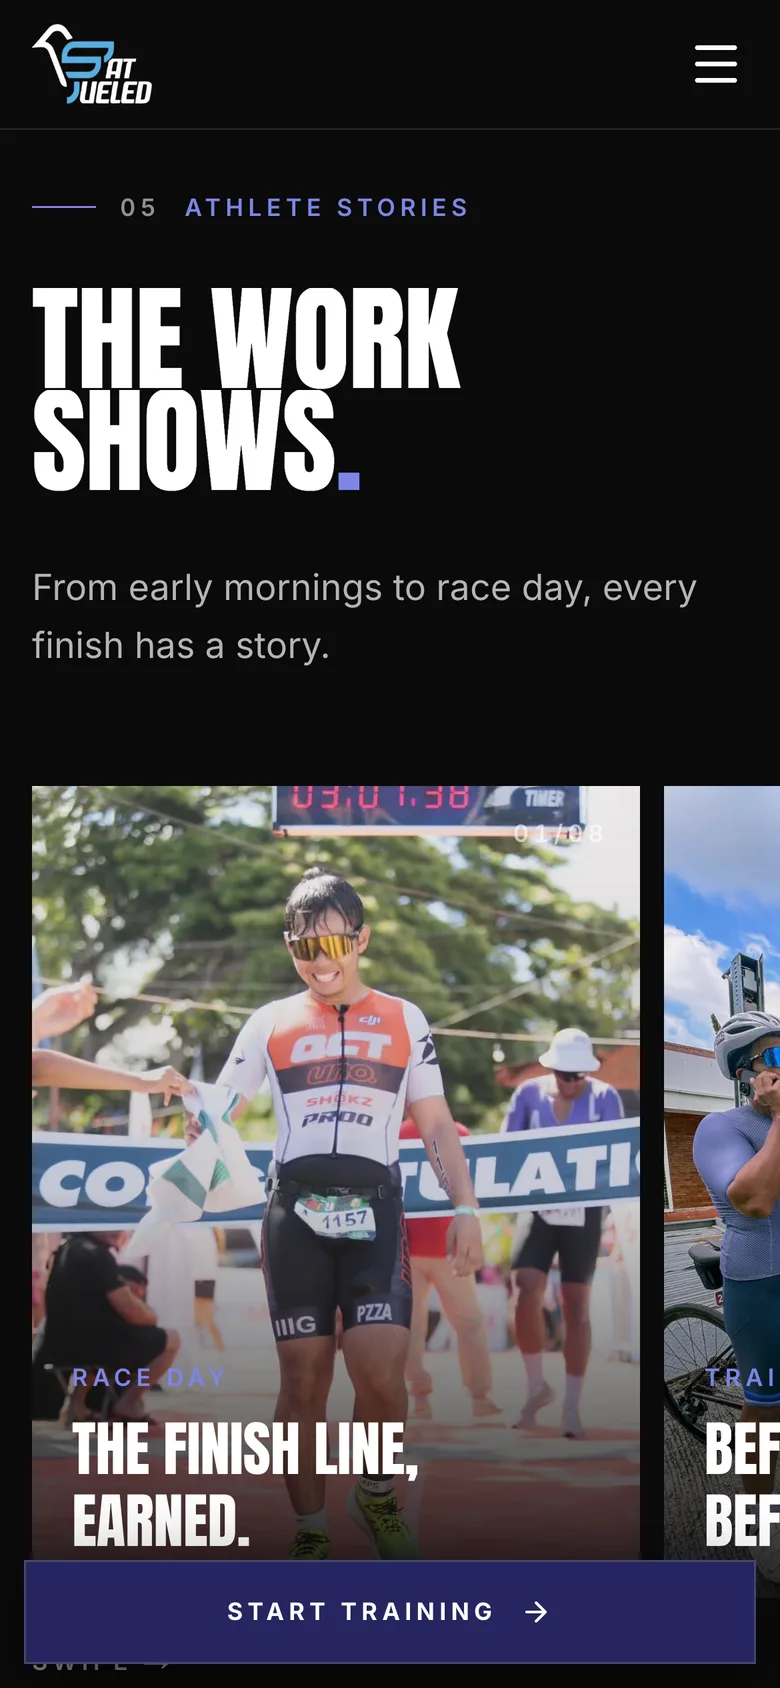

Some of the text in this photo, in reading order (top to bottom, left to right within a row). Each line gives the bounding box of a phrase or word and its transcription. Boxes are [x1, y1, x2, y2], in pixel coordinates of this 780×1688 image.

[121, 198, 467, 217] 05 ATHLETE STORIES
[32, 287, 461, 389] THE WORK
[33, 389, 360, 491] SHOWS.
[34, 572, 697, 609] From early mornings to race day, every
[32, 630, 329, 667] finish has a story.
[524, 789, 565, 808] TIMER
[322, 1210, 367, 1229] 1157
[228, 1601, 492, 1621] START TRAINING
